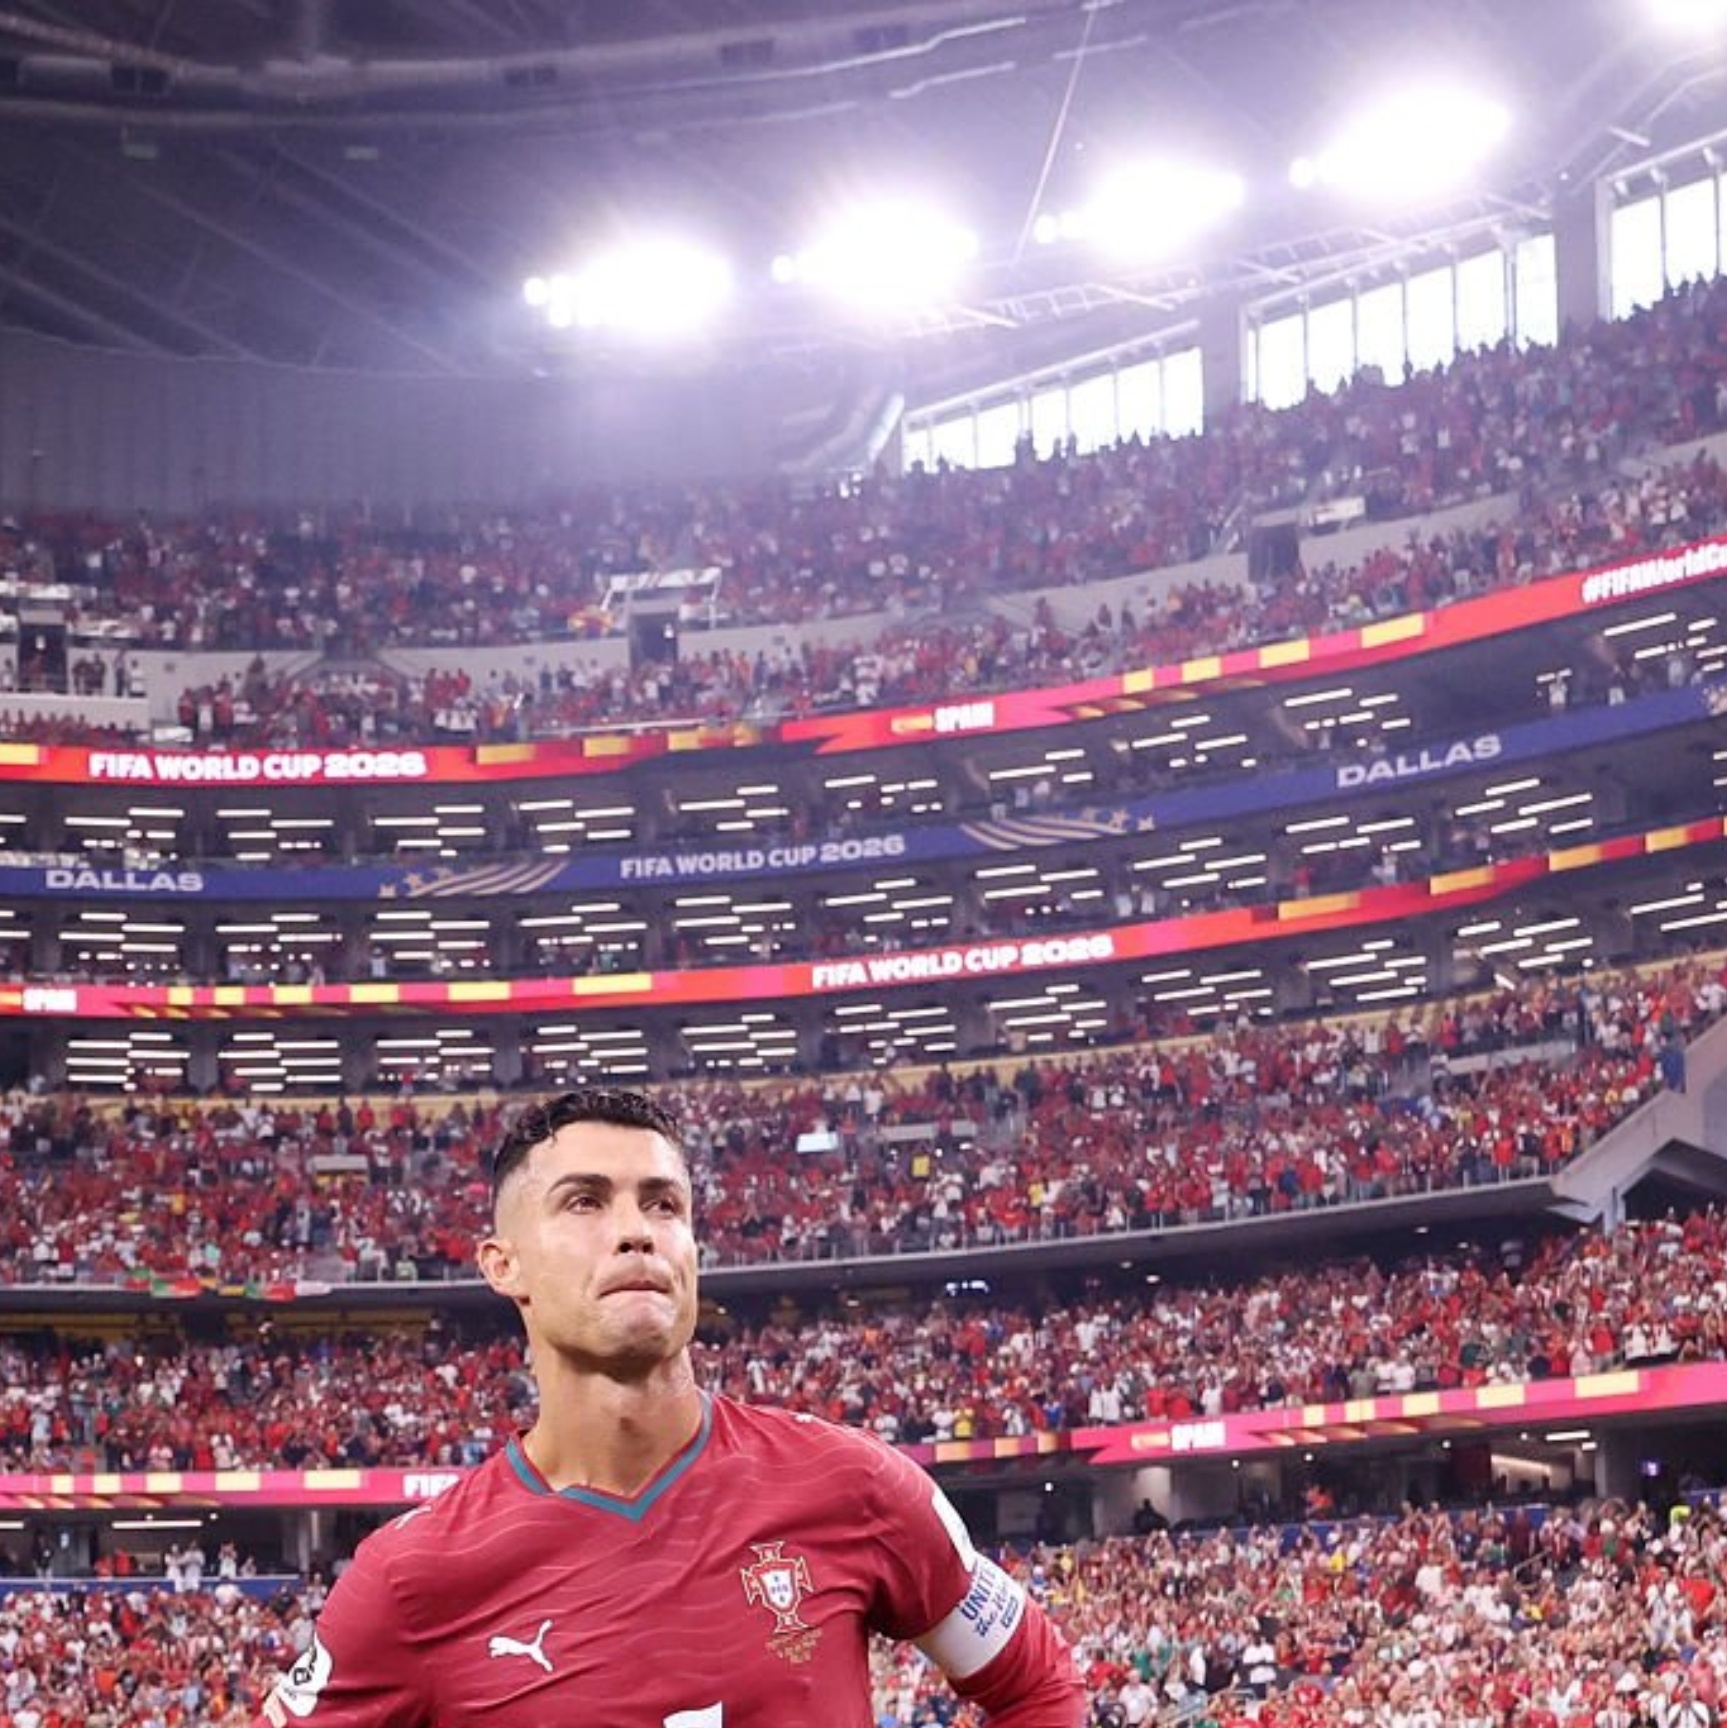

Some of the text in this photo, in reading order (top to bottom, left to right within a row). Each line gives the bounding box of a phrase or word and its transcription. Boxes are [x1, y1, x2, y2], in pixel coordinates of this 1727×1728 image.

[935, 701, 994, 733] SPAIN
[89, 751, 427, 780] FIFA WORLD CUP 2026
[1337, 734, 1502, 788] DALLAS
[621, 834, 906, 879] FIFA WORLD CUP 2026
[45, 870, 204, 892] DALLAS
[812, 935, 1115, 989] FIFA WORLD CUP 2026
